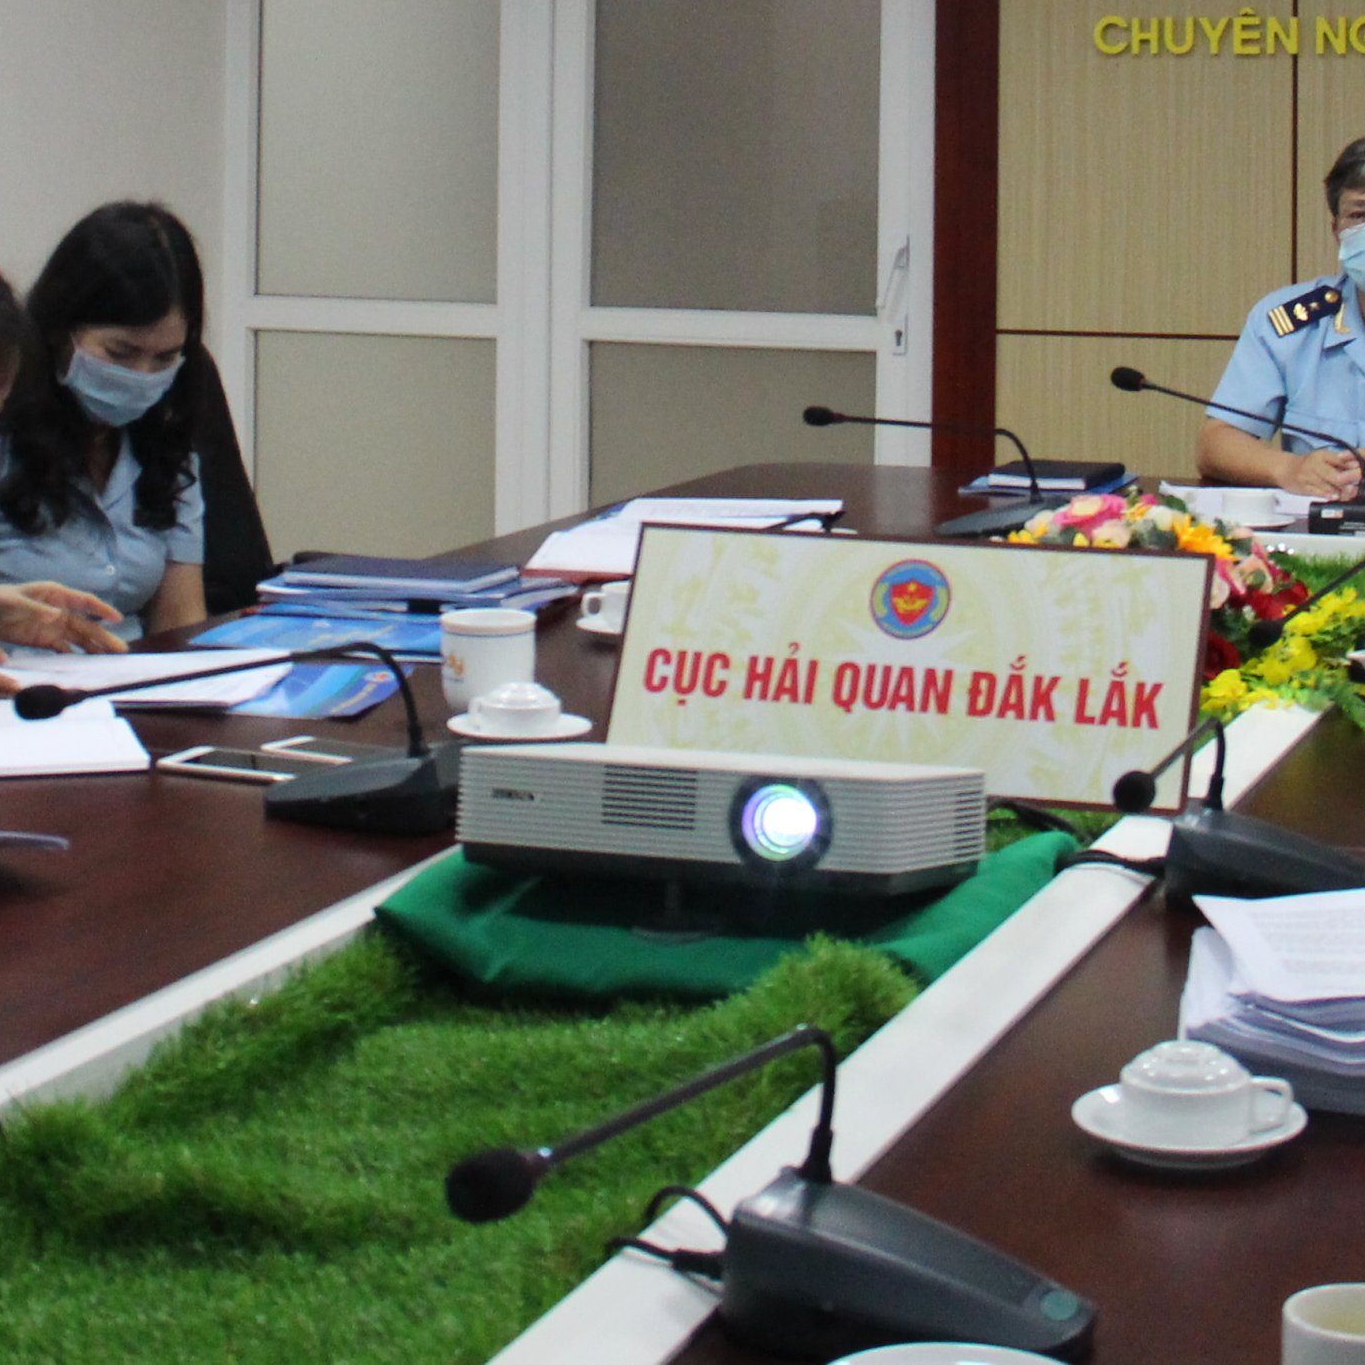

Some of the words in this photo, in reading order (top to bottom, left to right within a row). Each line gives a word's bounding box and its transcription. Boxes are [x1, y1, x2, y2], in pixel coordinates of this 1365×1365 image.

[1093, 6, 1300, 56] CHUYÊN
[643, 647, 731, 707] CỤC
[742, 641, 819, 705] HẢI
[831, 661, 953, 715] QUAN
[966, 654, 1061, 723] ĐẮK
[1073, 660, 1165, 730] LẮK
